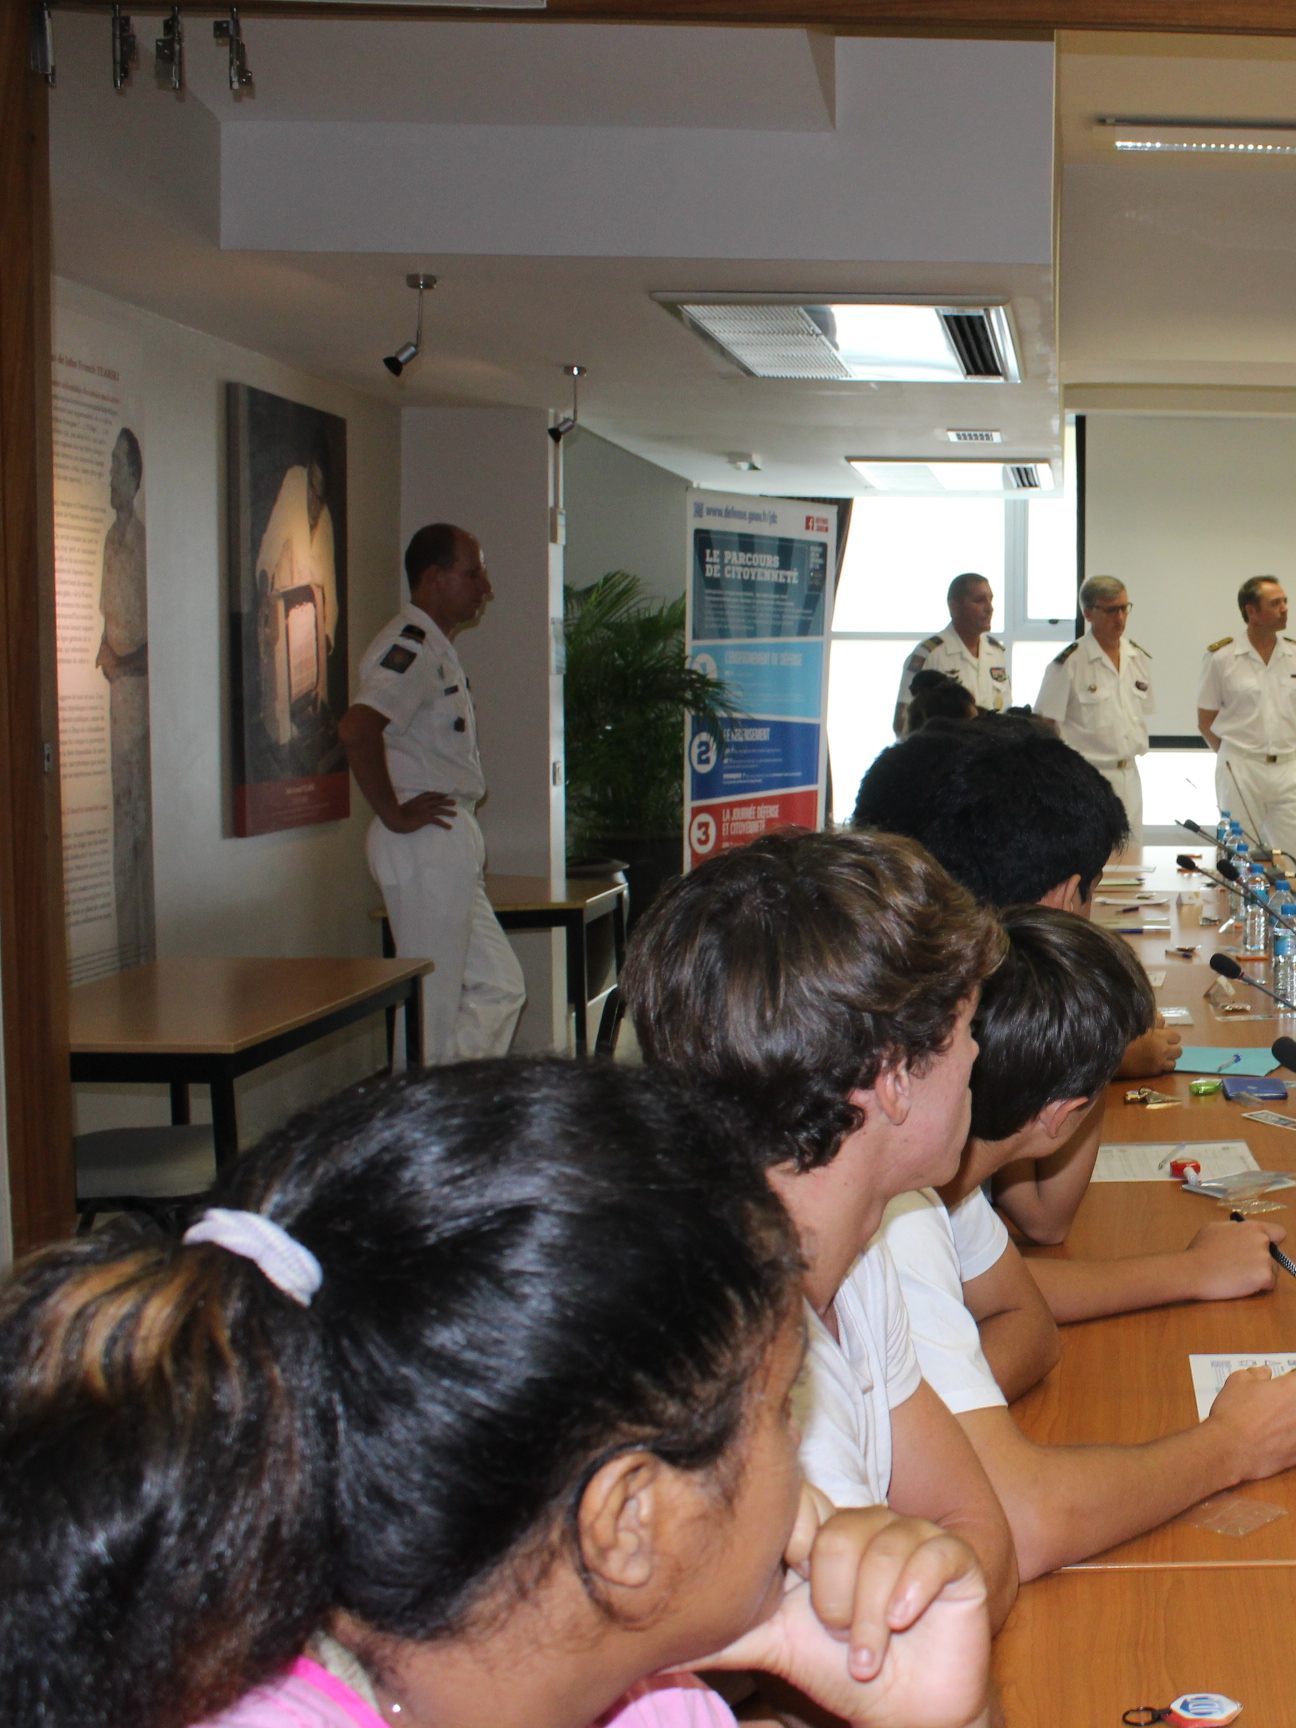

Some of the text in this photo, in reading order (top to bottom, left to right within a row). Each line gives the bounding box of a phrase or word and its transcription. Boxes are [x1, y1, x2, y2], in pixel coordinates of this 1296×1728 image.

[705, 549, 780, 568] LE PARCOURS
[705, 564, 798, 584] DE CITOYENNETÉ
[697, 741, 711, 765] 2
[722, 809, 731, 821] LA
[731, 804, 756, 820] JOURNÉE
[697, 822, 711, 846] 3
